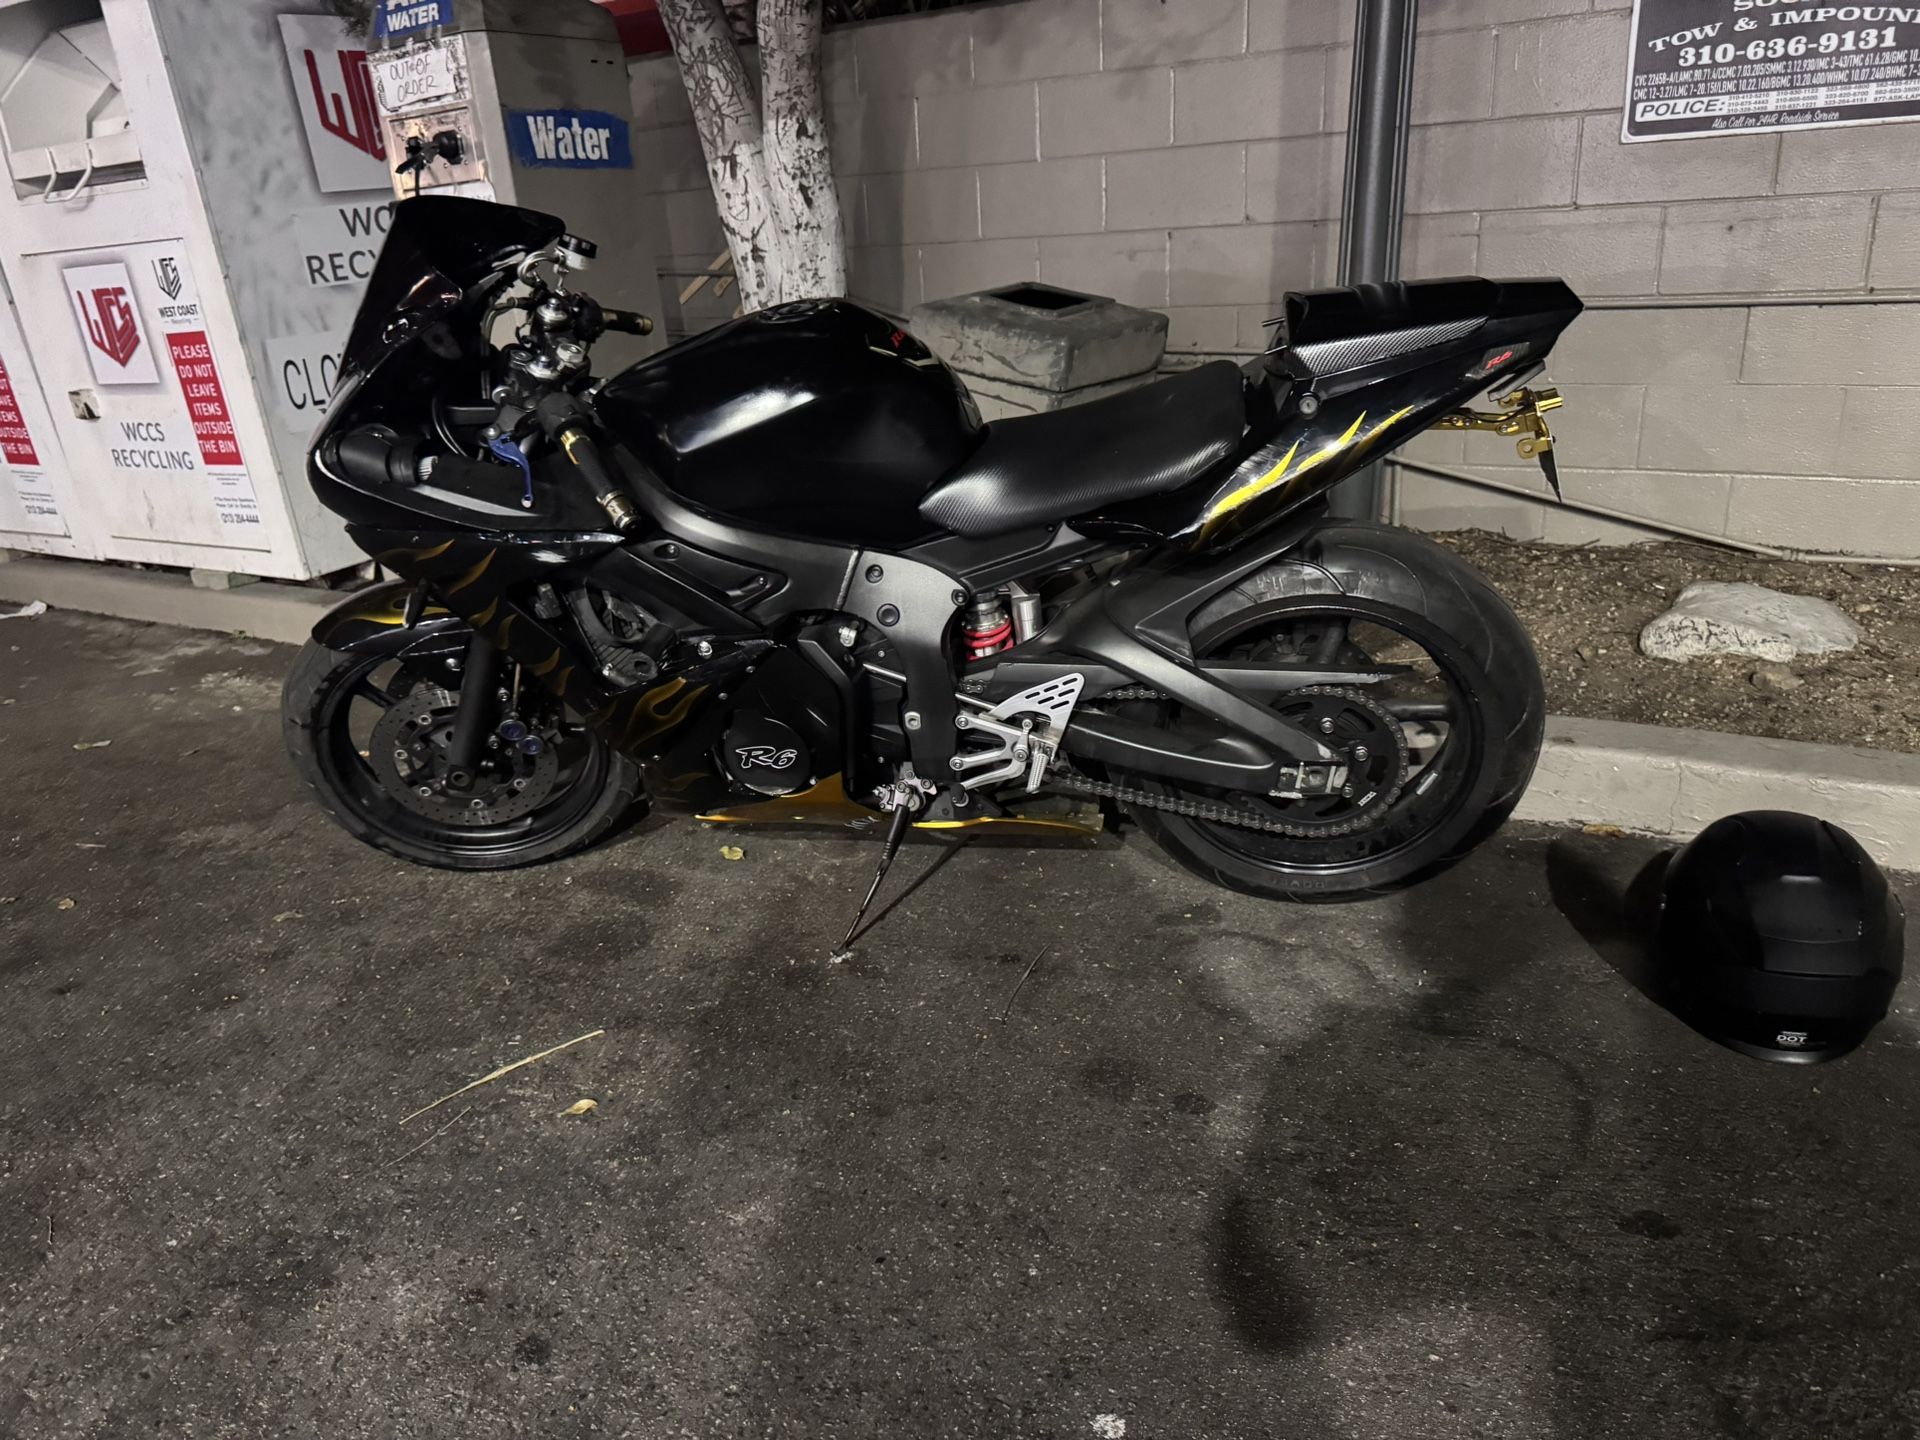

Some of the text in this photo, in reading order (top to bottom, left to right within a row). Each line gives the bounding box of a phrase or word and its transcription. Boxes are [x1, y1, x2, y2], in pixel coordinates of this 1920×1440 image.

[387, 3, 439, 32] WATER
[1648, 22, 1723, 52] TOW
[1733, 17, 1758, 31] &
[1678, 27, 1896, 67] 310-636-9131
[390, 54, 431, 80] OUT OF
[397, 75, 440, 102] ORDER
[1635, 75, 1647, 87] CVC
[1633, 87, 1648, 100] CMC
[1639, 99, 1725, 118] POLICE:
[1712, 117, 1727, 129] Also
[1728, 116, 1744, 128] Call
[1813, 110, 1840, 121] Service
[526, 115, 610, 161] Water
[158, 304, 198, 318] WEST COAST
[172, 344, 209, 359] PLEASE
[178, 364, 213, 378] DO NOT
[187, 383, 217, 397] LEAVE
[193, 402, 222, 416] ITEMS
[121, 422, 165, 442] WCCS
[194, 421, 233, 435] OUTSIDE
[1, 442, 18, 454] THE
[199, 440, 236, 453] THE BIN
[111, 449, 194, 470] RECYCLING
[735, 745, 797, 769] R6
[1776, 1034, 1807, 1042] DOT
